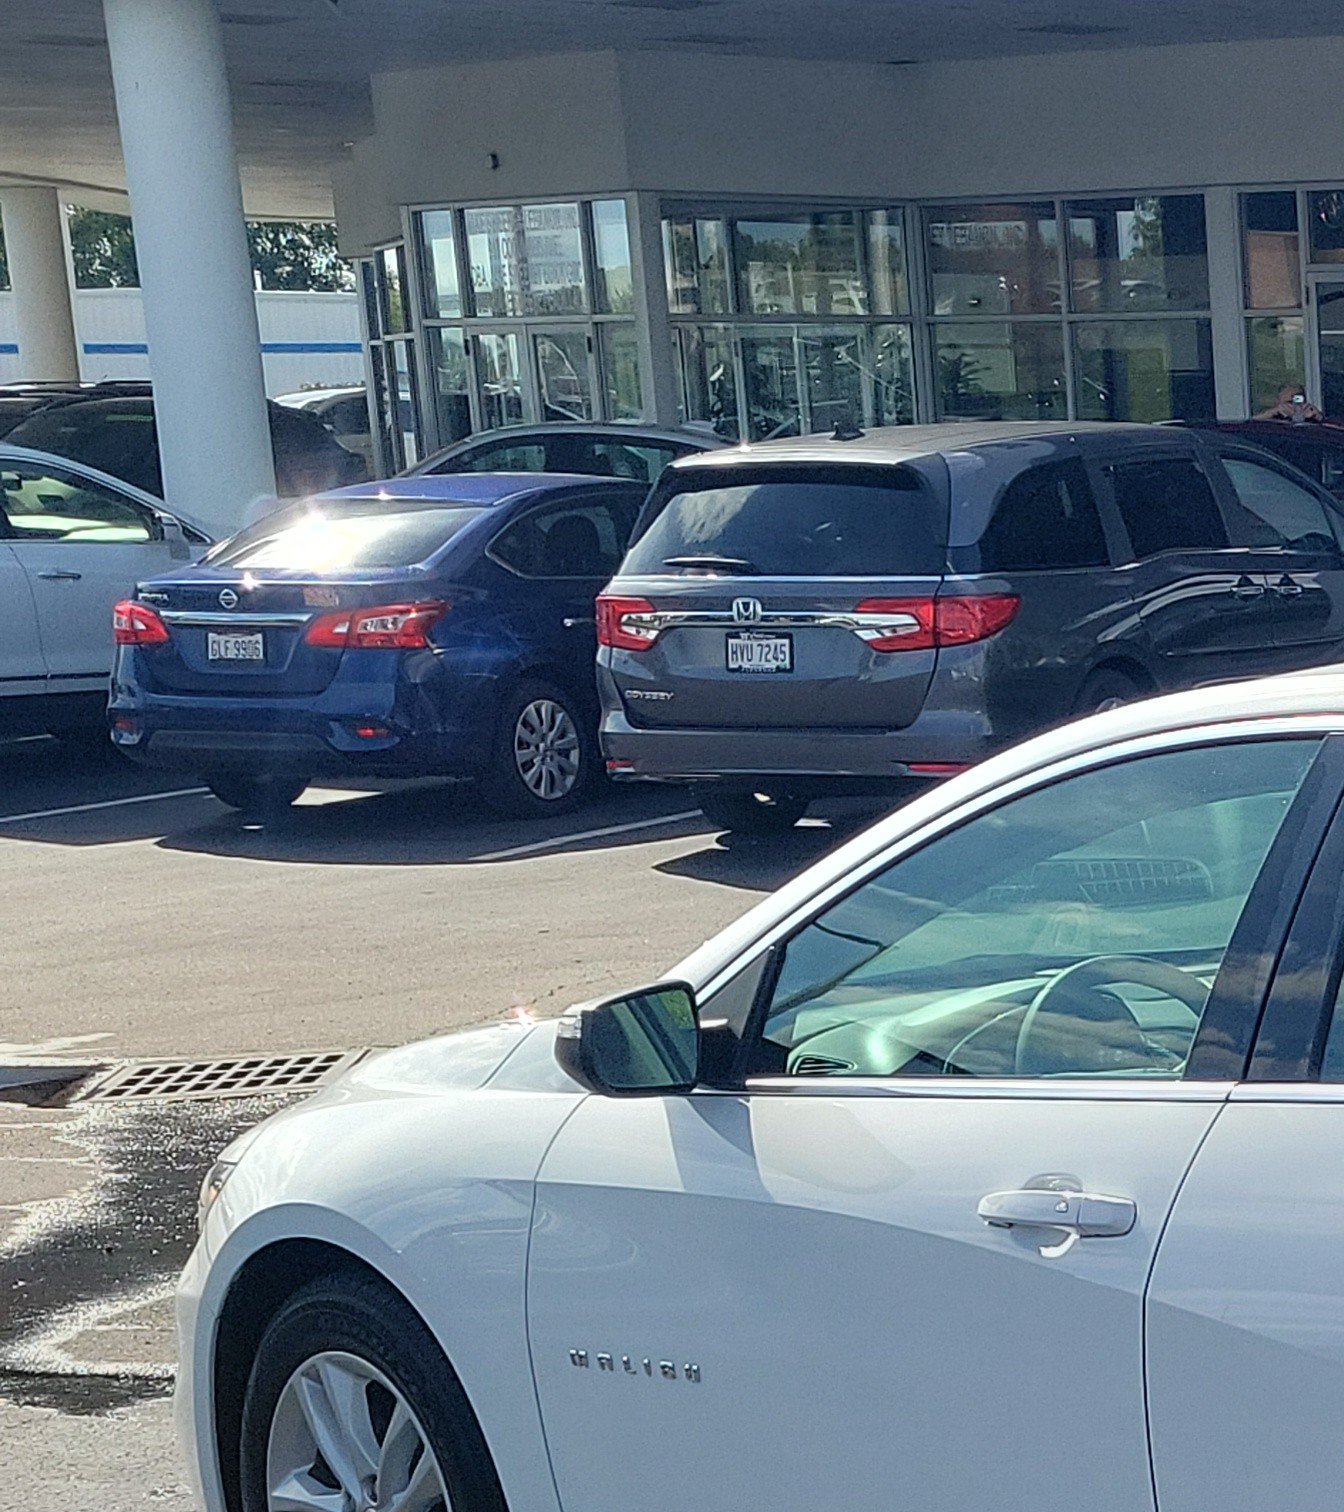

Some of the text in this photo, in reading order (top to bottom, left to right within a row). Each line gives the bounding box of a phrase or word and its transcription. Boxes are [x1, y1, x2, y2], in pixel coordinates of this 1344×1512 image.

[731, 643, 787, 663] HVU 7245
[624, 689, 674, 700] ODYSSEY
[569, 1349, 701, 1383] MALIBU
